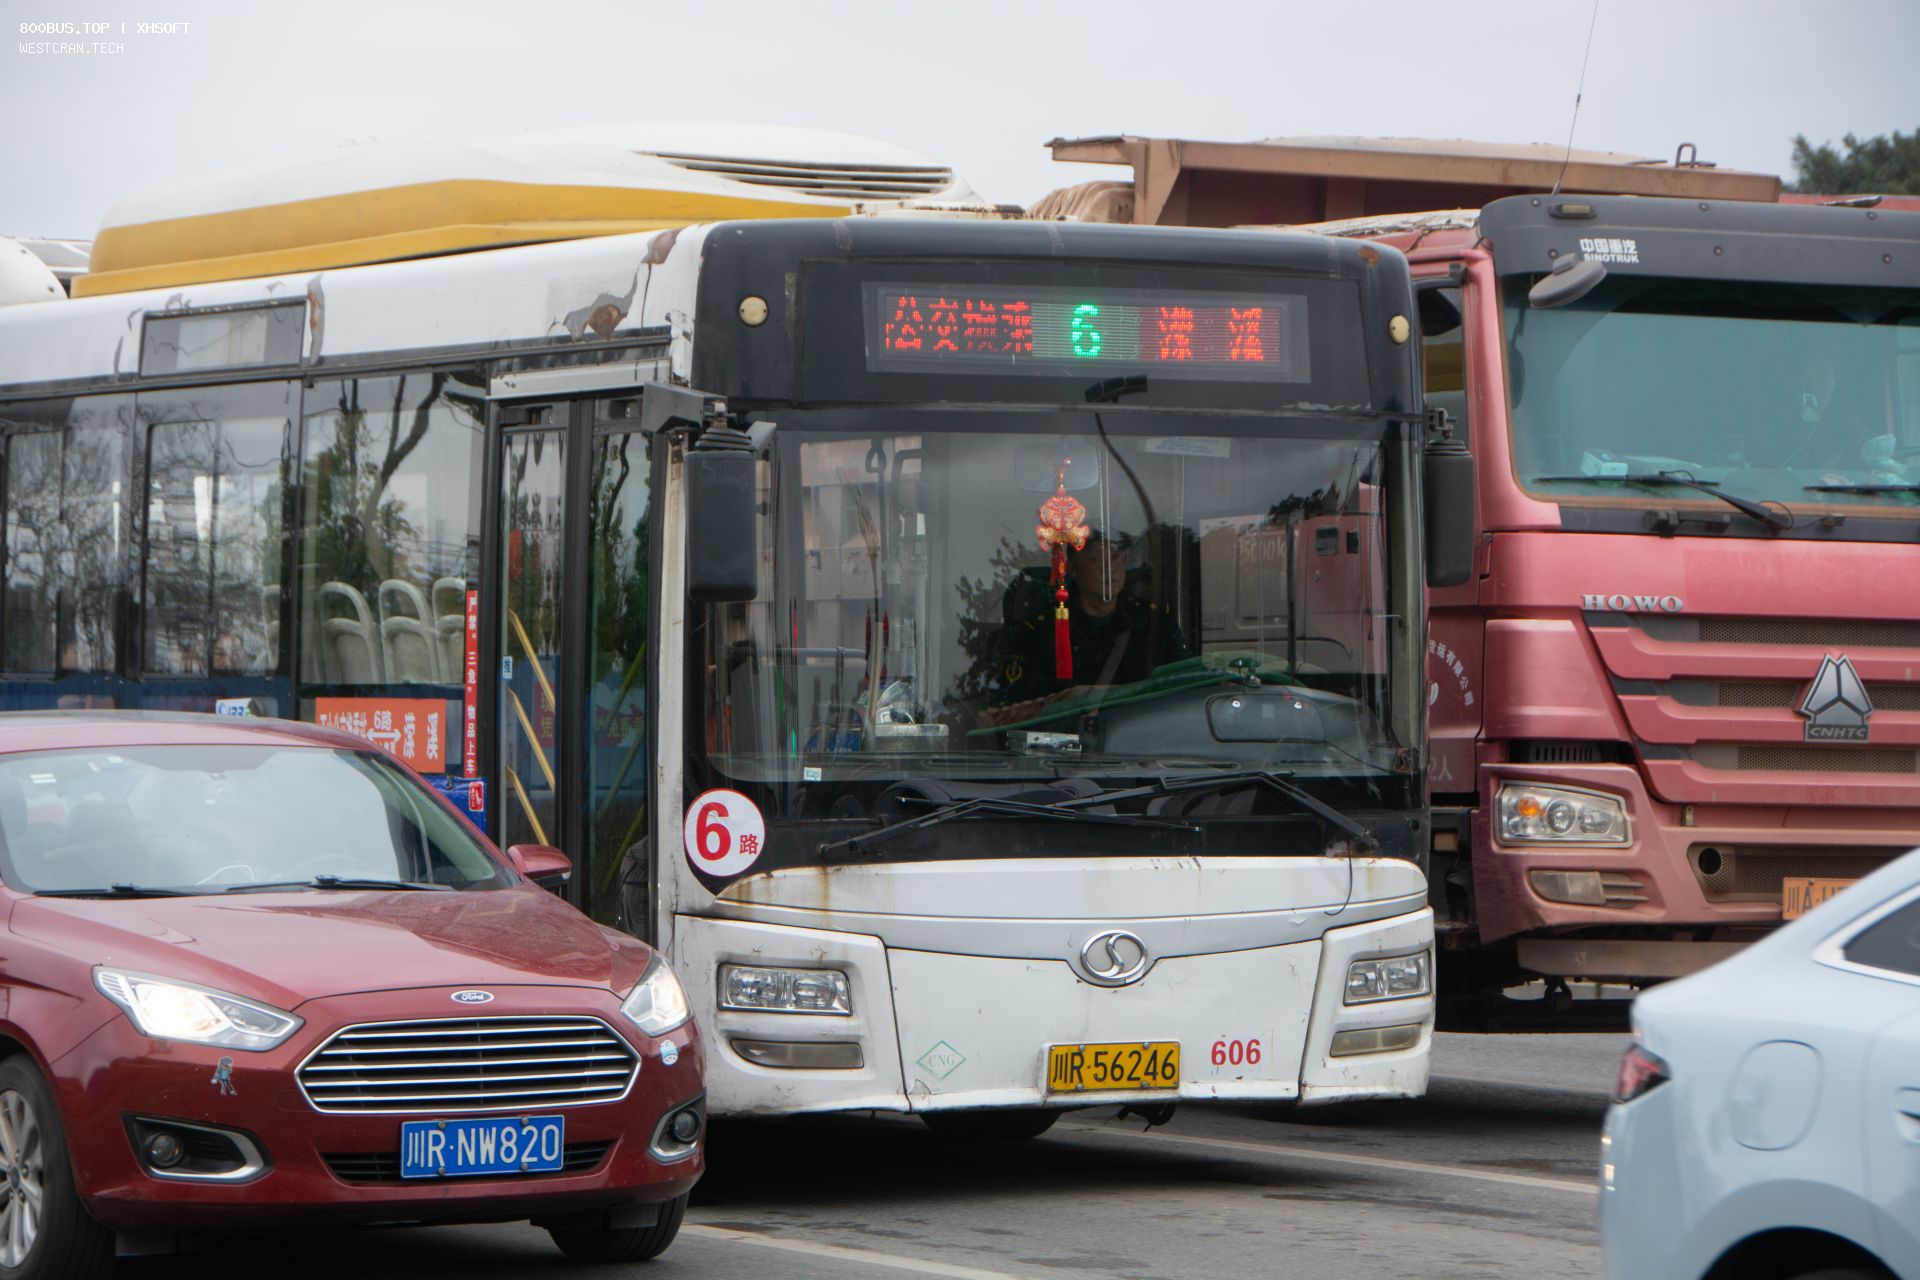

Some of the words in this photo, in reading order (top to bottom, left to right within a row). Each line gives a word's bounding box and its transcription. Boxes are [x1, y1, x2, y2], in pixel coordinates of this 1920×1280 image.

[1580, 238, 1638, 254] 中国重汽
[1583, 253, 1640, 264] SINOTRUK
[1071, 304, 1100, 357] 6
[1582, 594, 1684, 613] HOWO
[1809, 726, 1867, 738] CNHTC
[696, 801, 759, 861] 6路
[461, 992, 485, 1001] Ford
[928, 1053, 957, 1068] CNG
[1211, 1039, 1262, 1066] 606
[1052, 1049, 1177, 1084] 川R·56246
[406, 1123, 560, 1168] 川R·NW820
